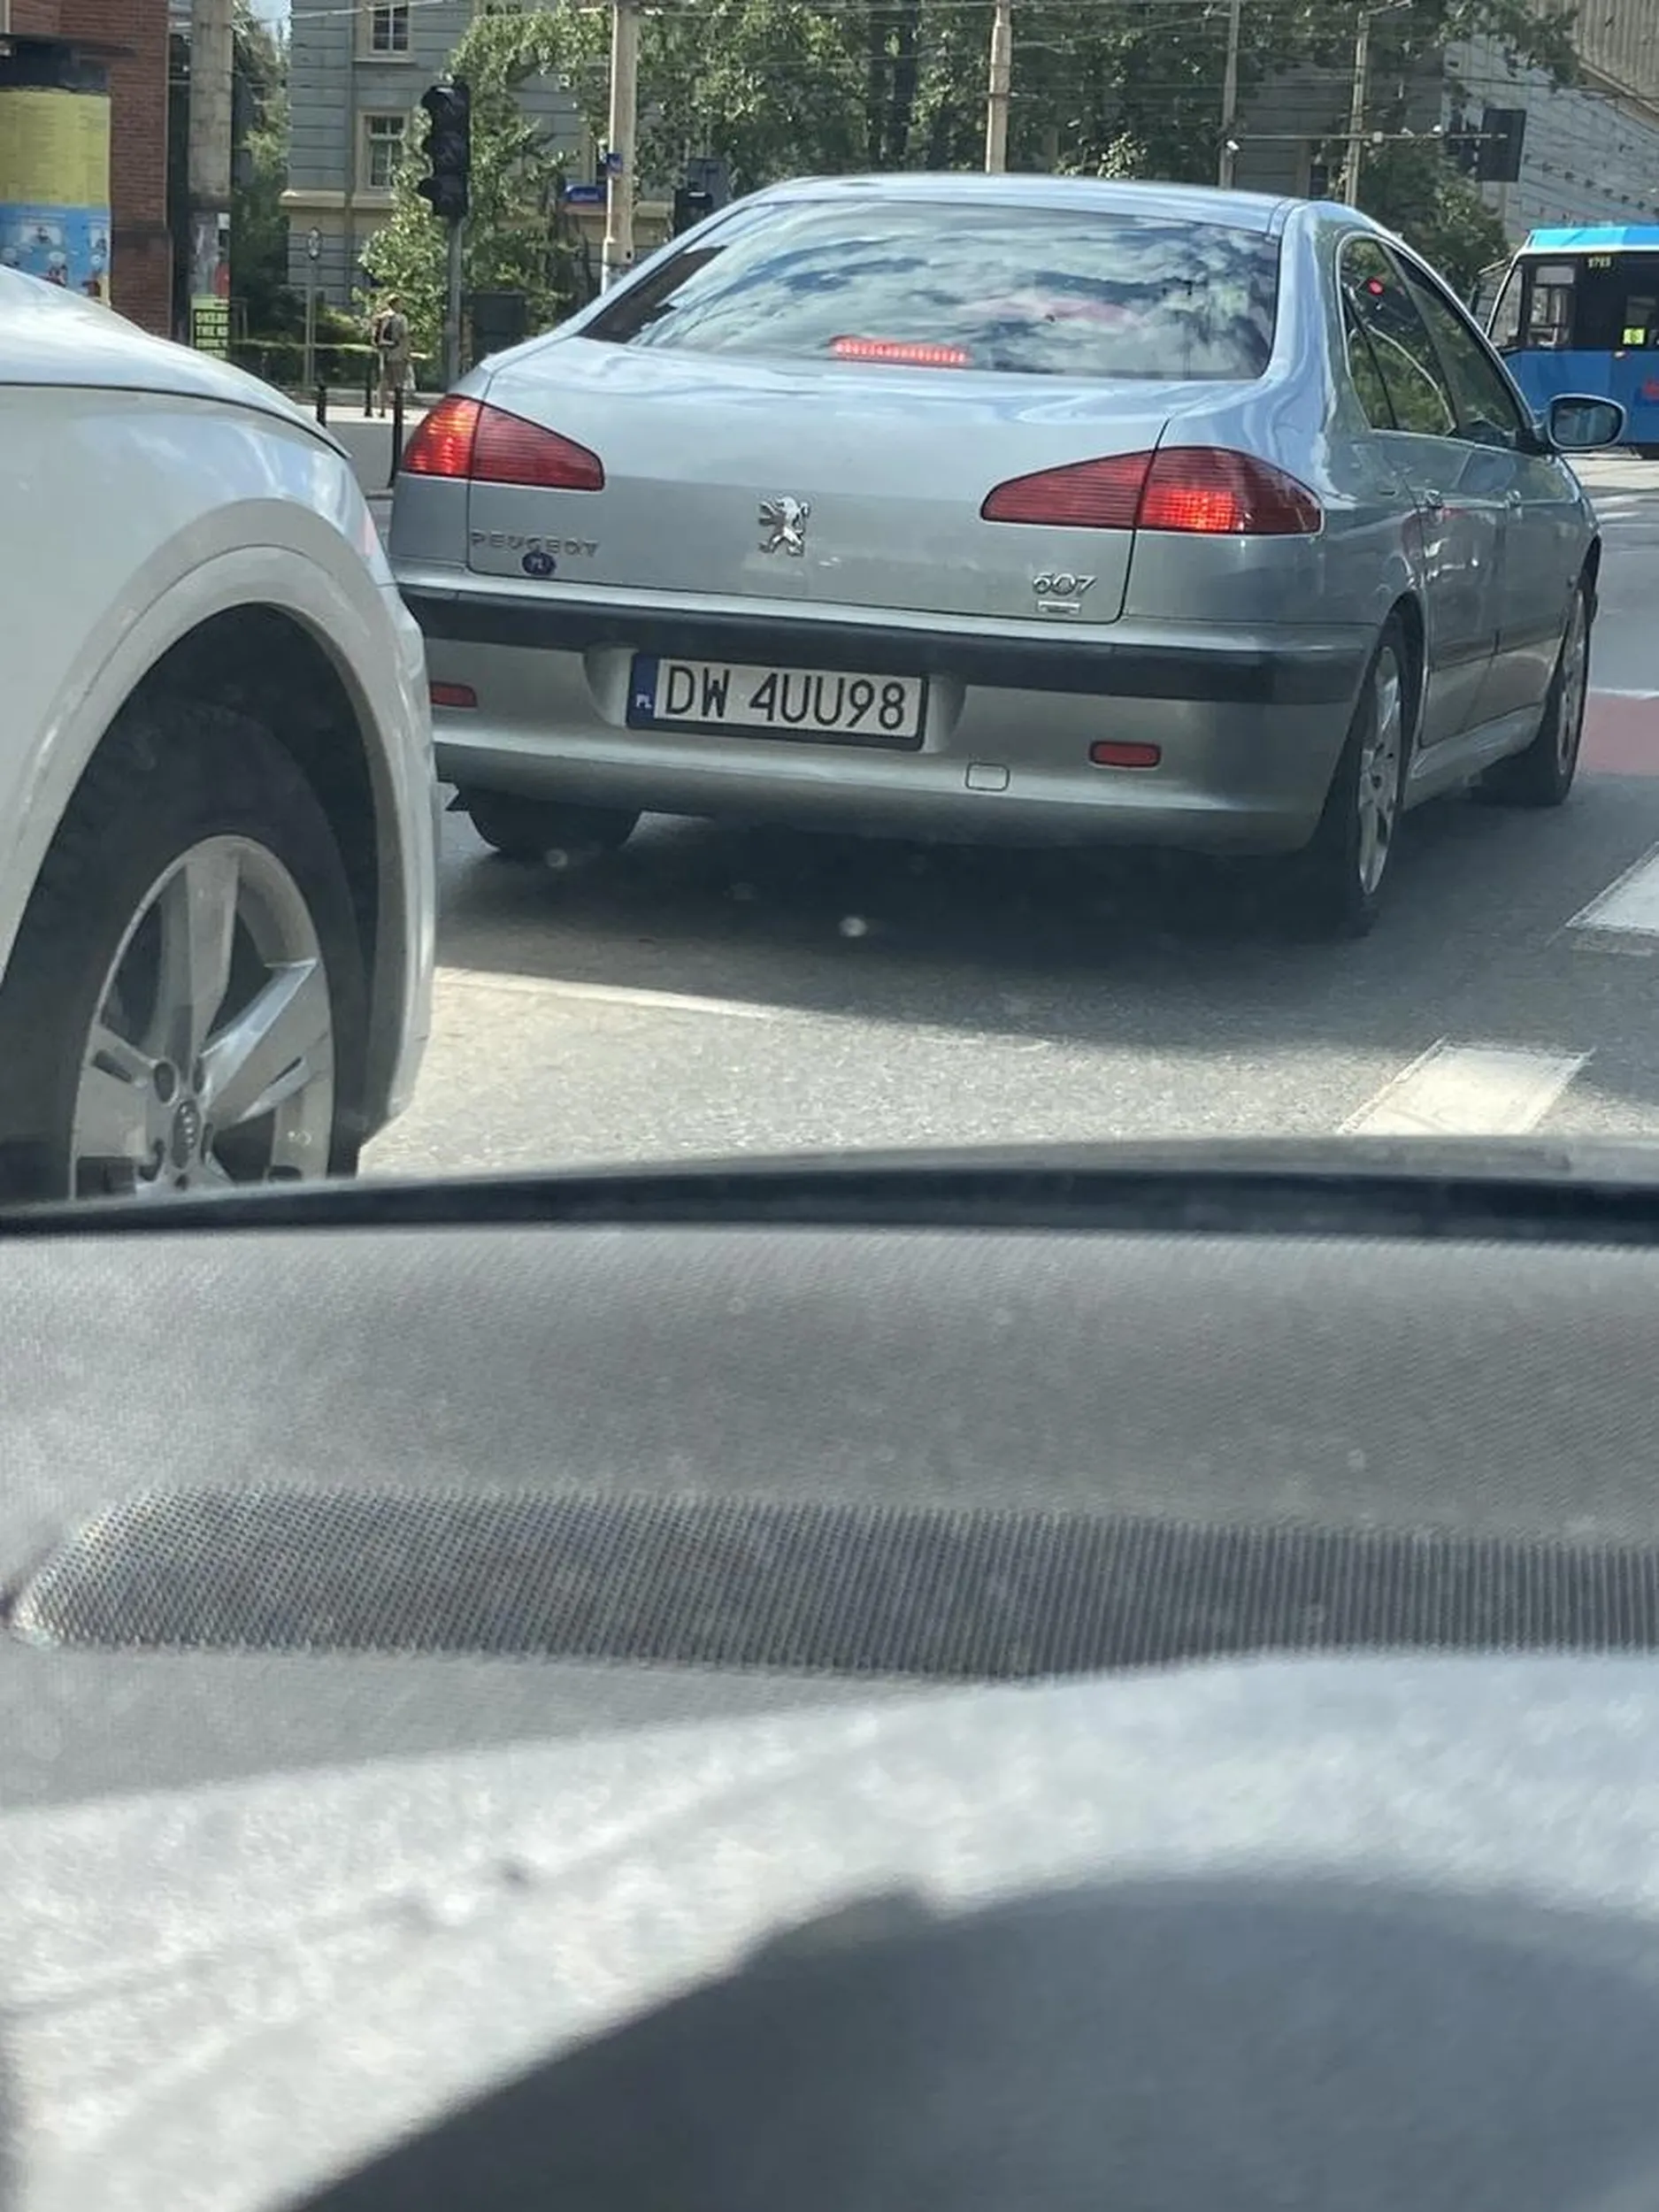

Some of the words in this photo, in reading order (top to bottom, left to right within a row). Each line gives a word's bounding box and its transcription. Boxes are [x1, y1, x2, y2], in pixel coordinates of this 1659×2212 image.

[471, 530, 599, 557] PEUGEOT
[1033, 572, 1097, 596] 607
[636, 693, 652, 709] PL
[664, 664, 730, 718] DW
[749, 672, 905, 730] 4UU98
